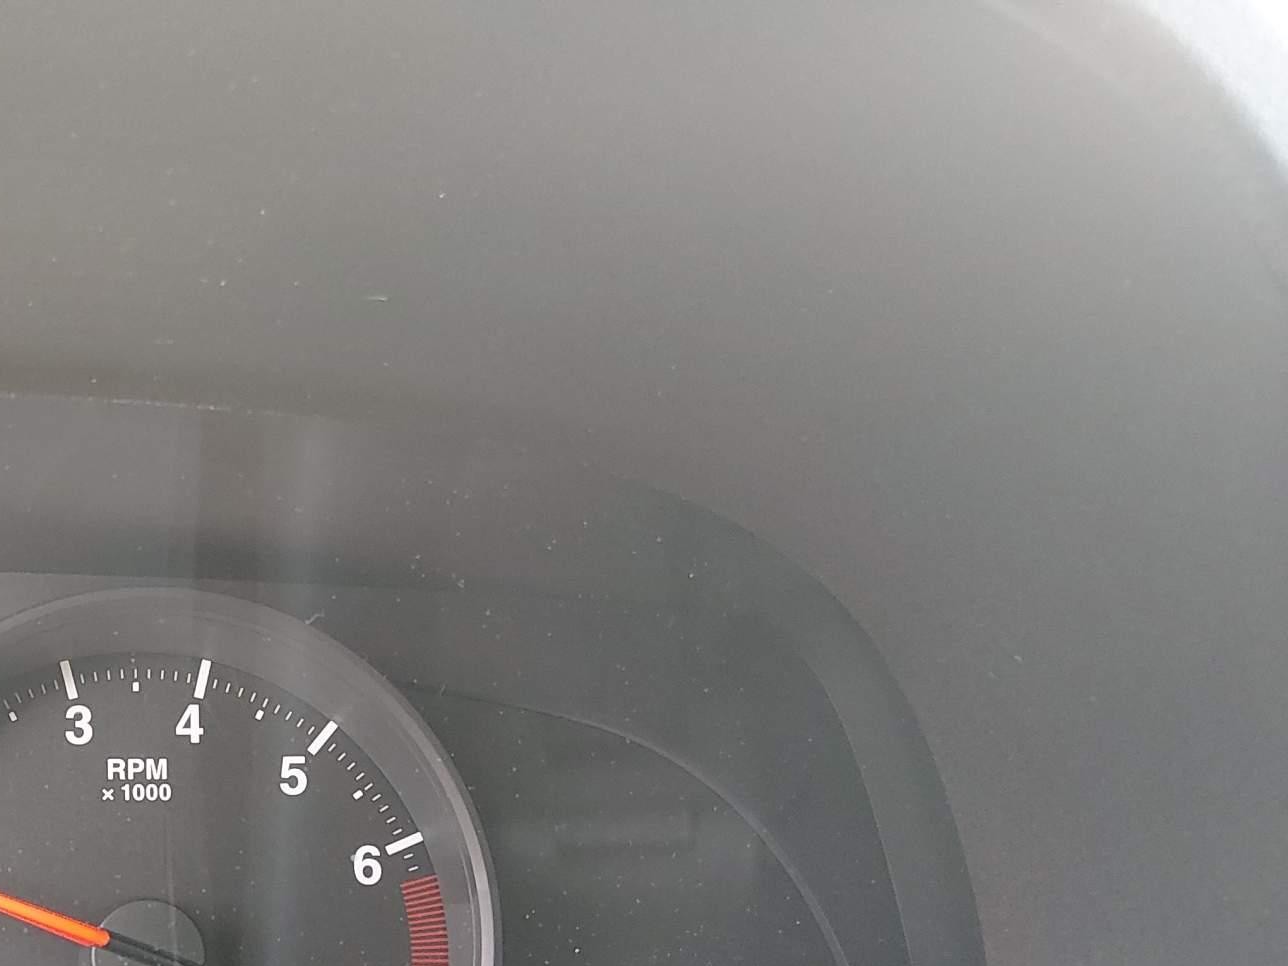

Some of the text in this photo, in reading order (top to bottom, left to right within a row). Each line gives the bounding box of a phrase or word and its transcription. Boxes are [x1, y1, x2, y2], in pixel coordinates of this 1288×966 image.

[65, 706, 94, 745] 3
[175, 705, 204, 744] 4
[107, 759, 169, 780] RPM
[279, 756, 309, 796] 5
[120, 784, 172, 801] 1000
[353, 846, 383, 886] 6
